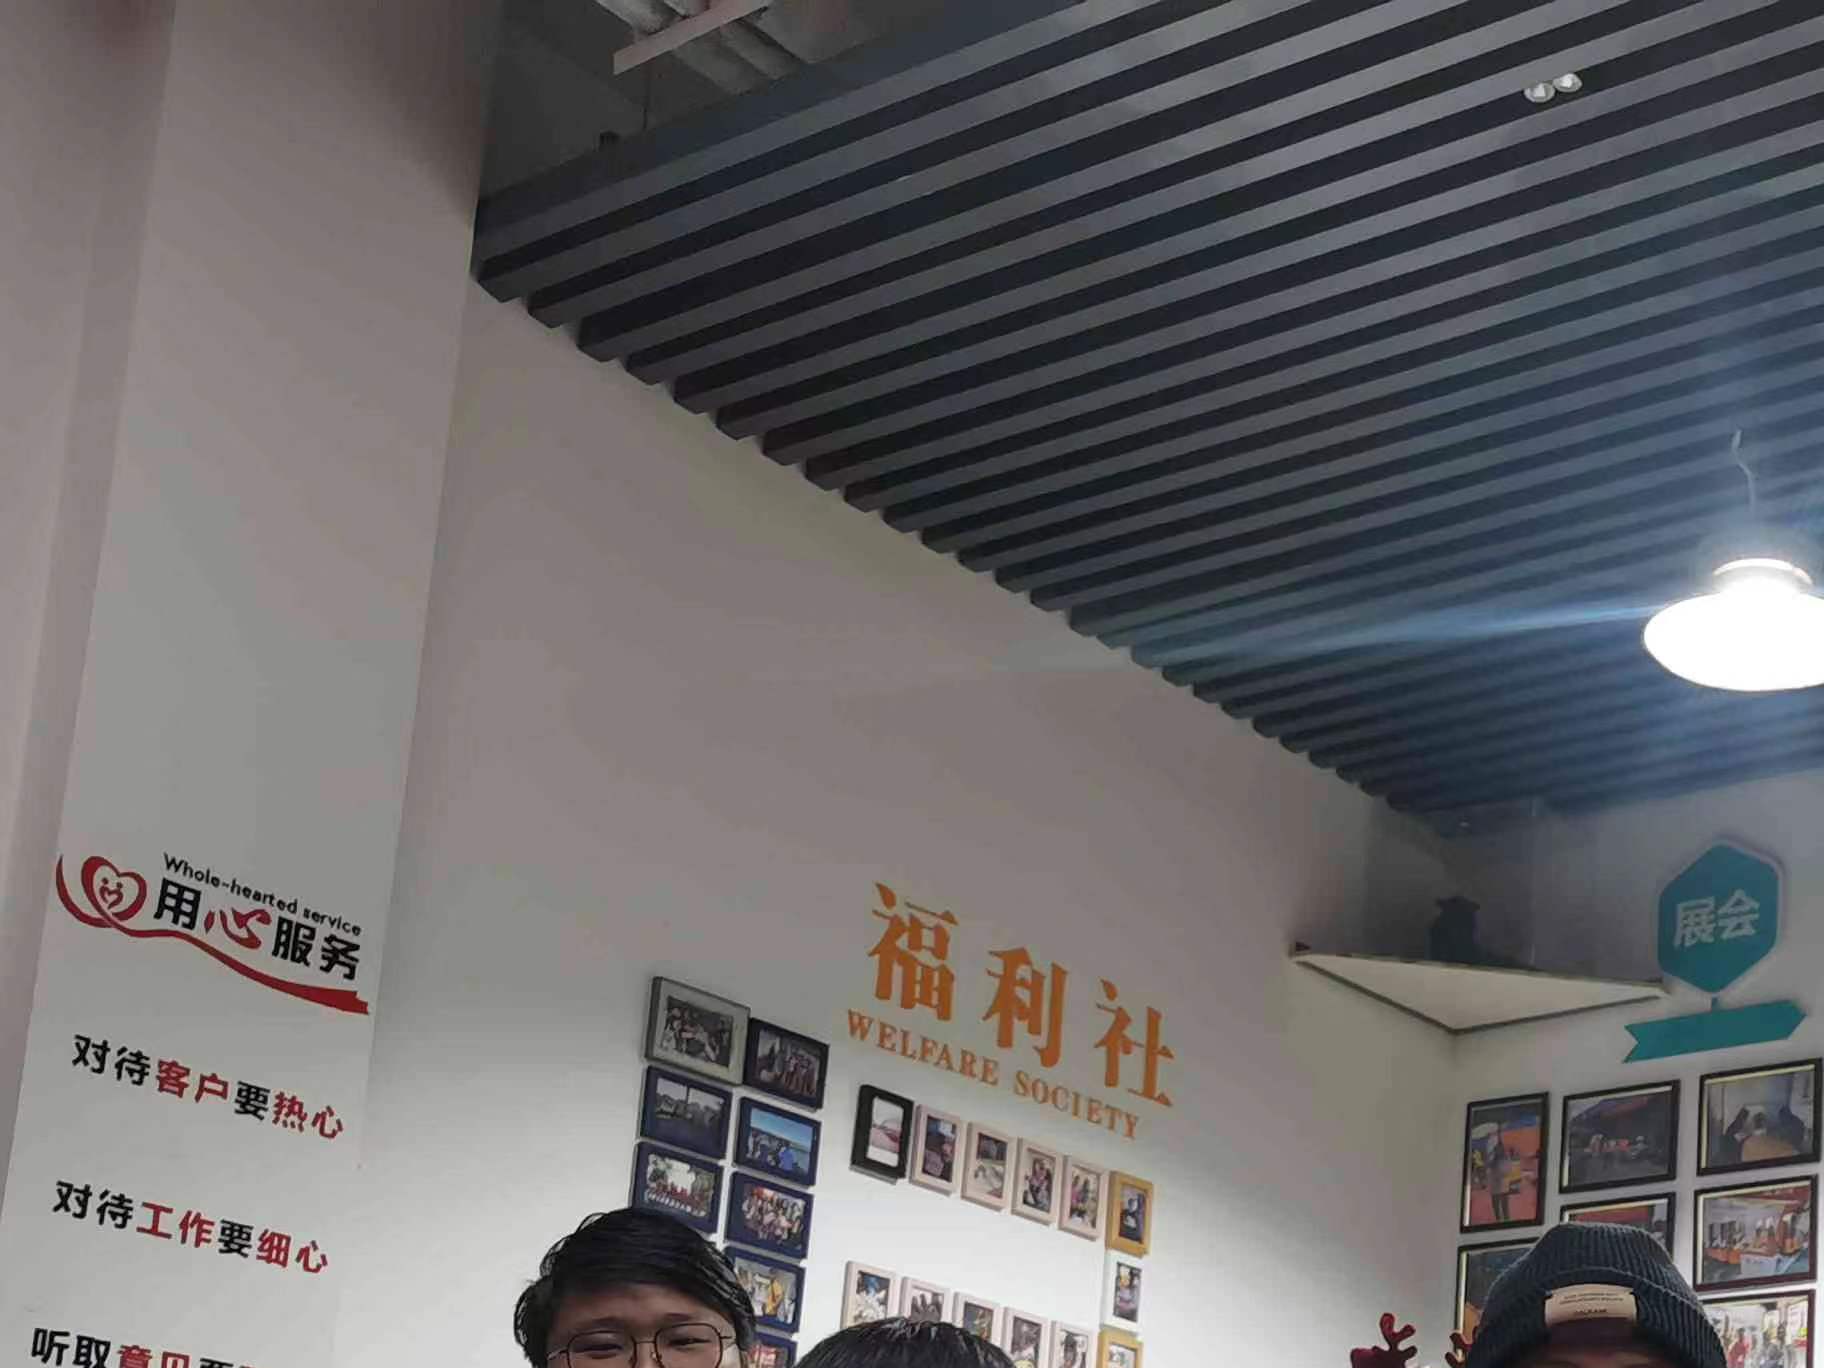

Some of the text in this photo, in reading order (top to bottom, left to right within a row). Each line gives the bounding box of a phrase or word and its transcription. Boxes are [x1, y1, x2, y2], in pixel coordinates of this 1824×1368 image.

[154, 877, 361, 981] 用心服务
[163, 851, 362, 937] Whole-hearted service
[1673, 888, 1761, 948] 展会
[867, 881, 1175, 1107] 福利社
[72, 1034, 345, 1140] 对待客户要热心
[848, 1008, 1140, 1139] WELFARE SOCIETY
[52, 1180, 328, 1274] 对待工作要细心
